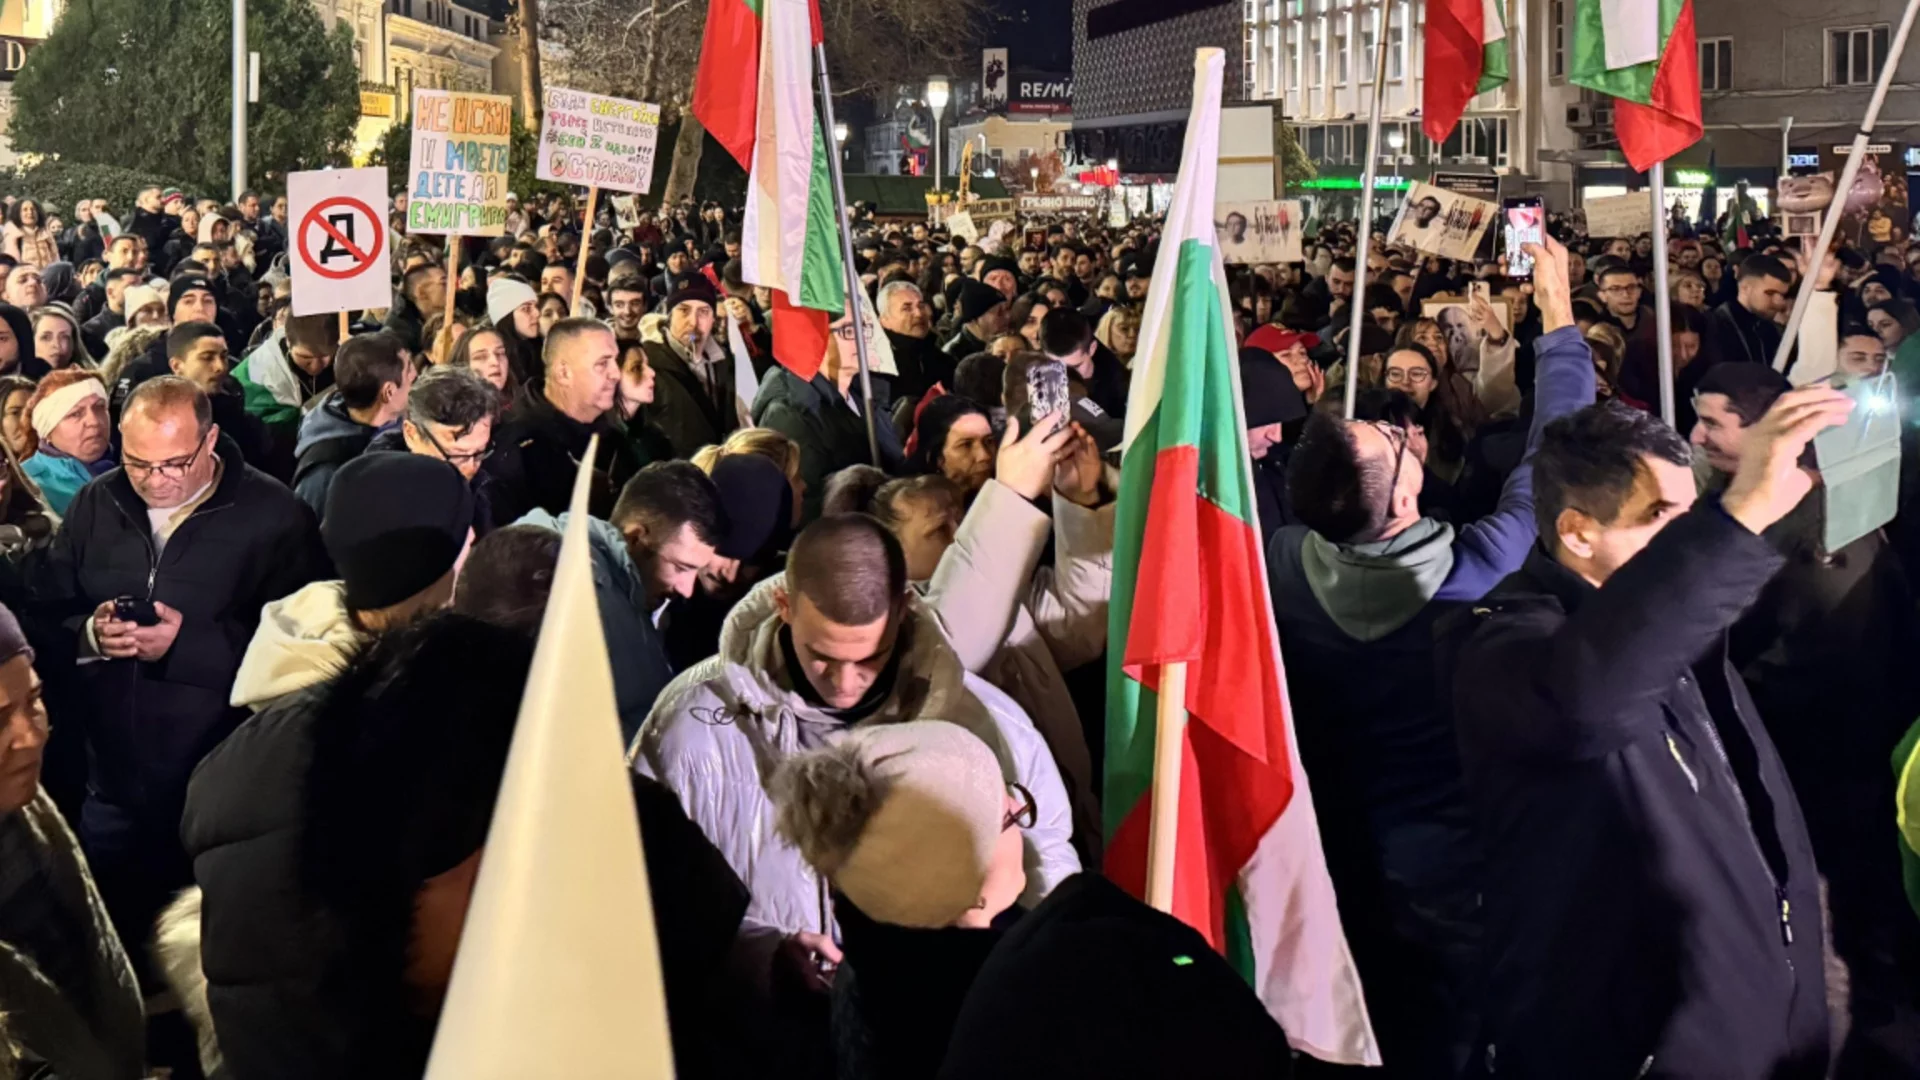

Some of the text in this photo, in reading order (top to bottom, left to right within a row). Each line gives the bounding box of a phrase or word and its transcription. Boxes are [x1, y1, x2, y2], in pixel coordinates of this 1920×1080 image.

[416, 97, 450, 132] НЕ
[420, 138, 509, 173] И МОЕТО
[550, 151, 646, 188] ОСТАВКА!
[413, 171, 498, 202] ДЕТЕ ДА
[1020, 196, 1063, 208] ГРЕЯНО
[1066, 195, 1096, 207] ВИНО
[409, 201, 506, 229] ЕМИГРИРА
[319, 212, 363, 264] Д
